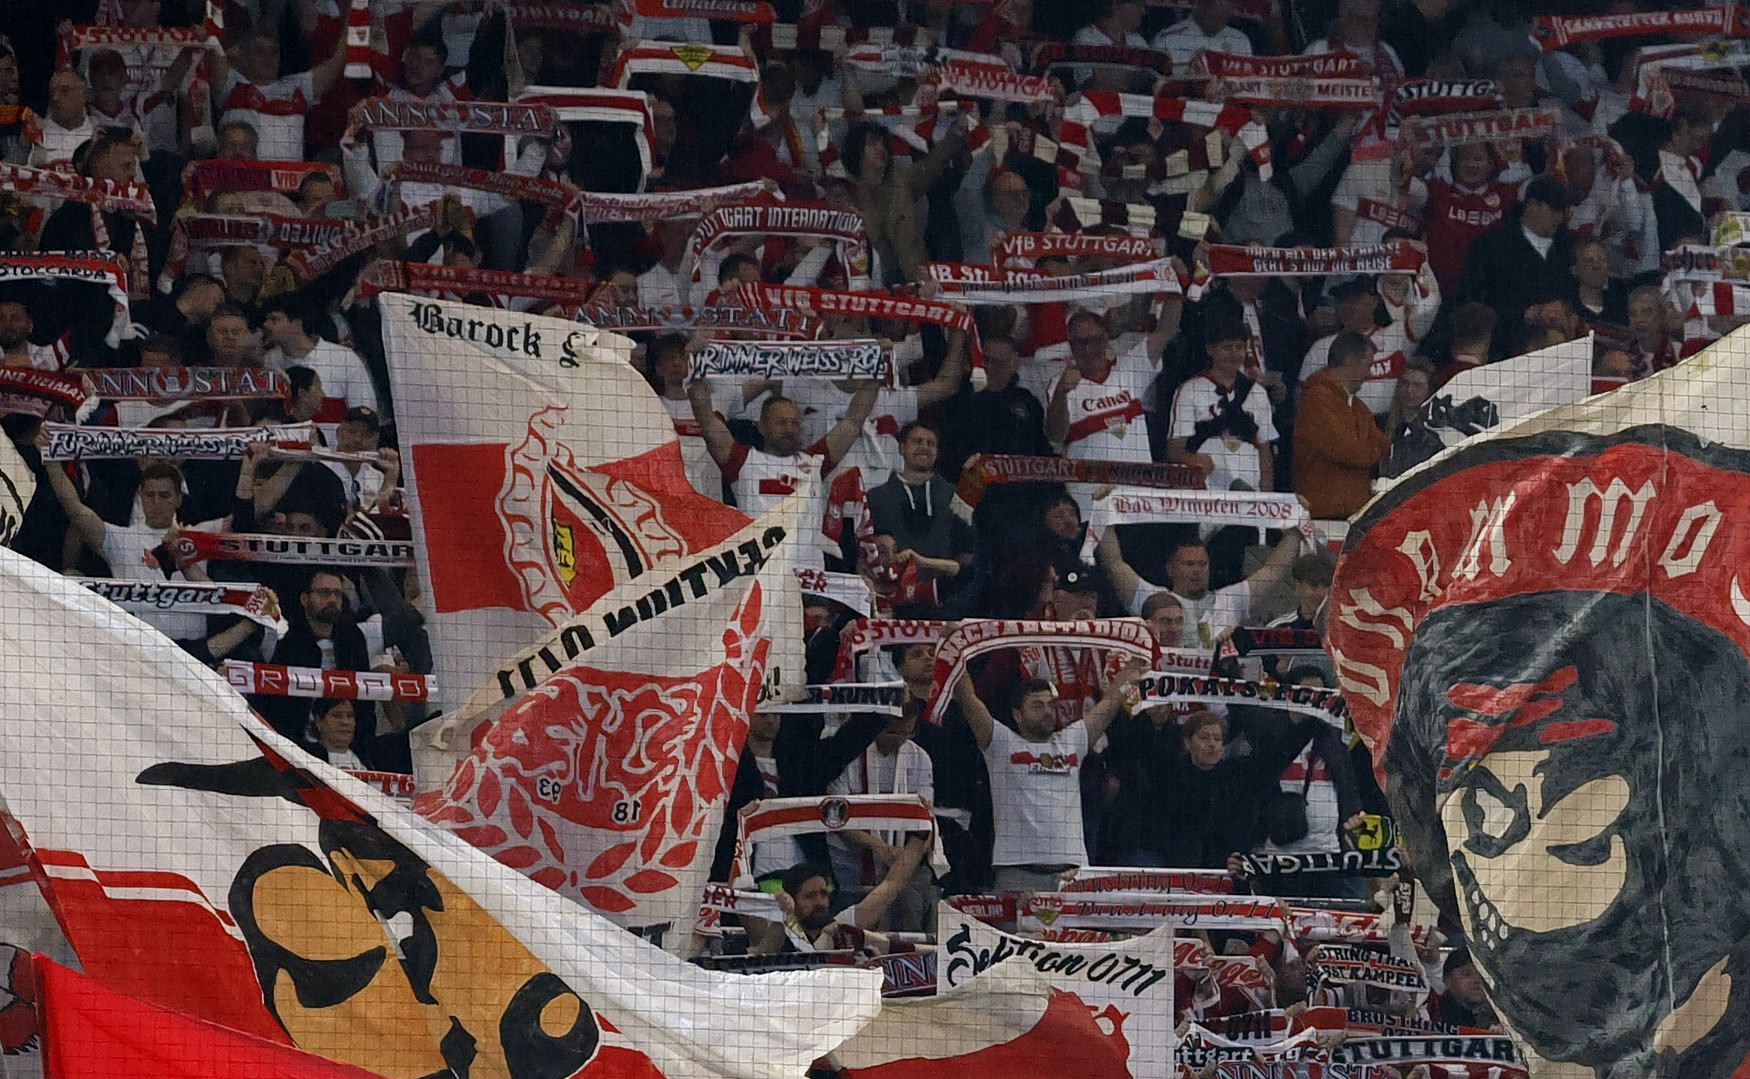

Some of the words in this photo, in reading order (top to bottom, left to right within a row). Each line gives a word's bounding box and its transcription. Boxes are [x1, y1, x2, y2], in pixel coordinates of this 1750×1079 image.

[1402, 81, 1491, 98] STUTTG
[1041, 236, 1152, 259] STUTTGART
[409, 303, 542, 359] Barock
[720, 343, 786, 375] IMMER
[194, 370, 281, 397] STAT
[1112, 497, 1150, 516] Bad
[1160, 495, 1240, 518] Wimpfen
[1248, 500, 1292, 520] 2008
[219, 538, 414, 556] STUTTGAR
[1087, 950, 1167, 996] 0711
[1176, 1048, 1253, 1069] uttgart
[1337, 1037, 1516, 1061] STUTTGAR
